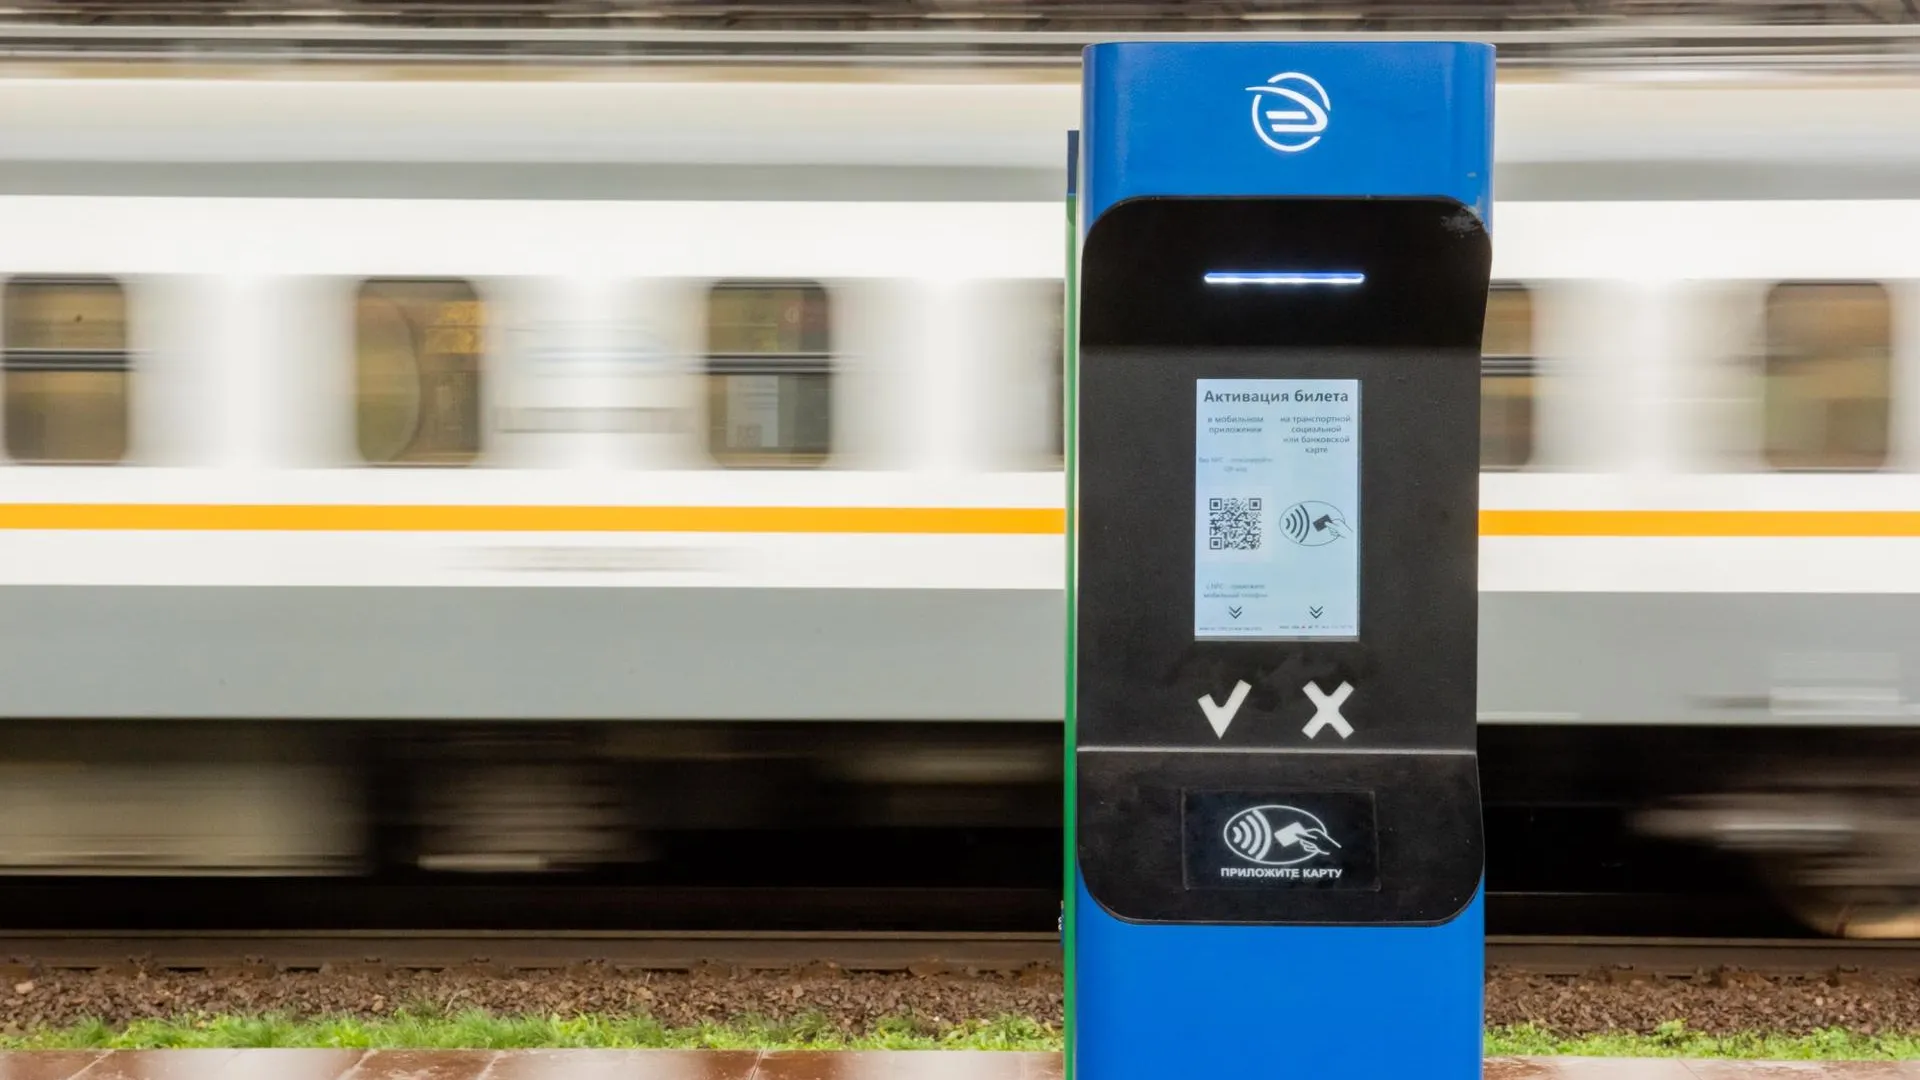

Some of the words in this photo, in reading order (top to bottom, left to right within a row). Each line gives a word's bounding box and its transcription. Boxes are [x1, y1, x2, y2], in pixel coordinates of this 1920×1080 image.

[1204, 390, 1289, 405] Активация
[1294, 389, 1349, 402] билета
[1293, 414, 1351, 425] транспортной
[1291, 425, 1342, 434] социальной
[1305, 446, 1328, 455] карте
[1220, 867, 1300, 879] ПРИЛОЖИТЕ
[1303, 868, 1343, 878] КАРТУ
